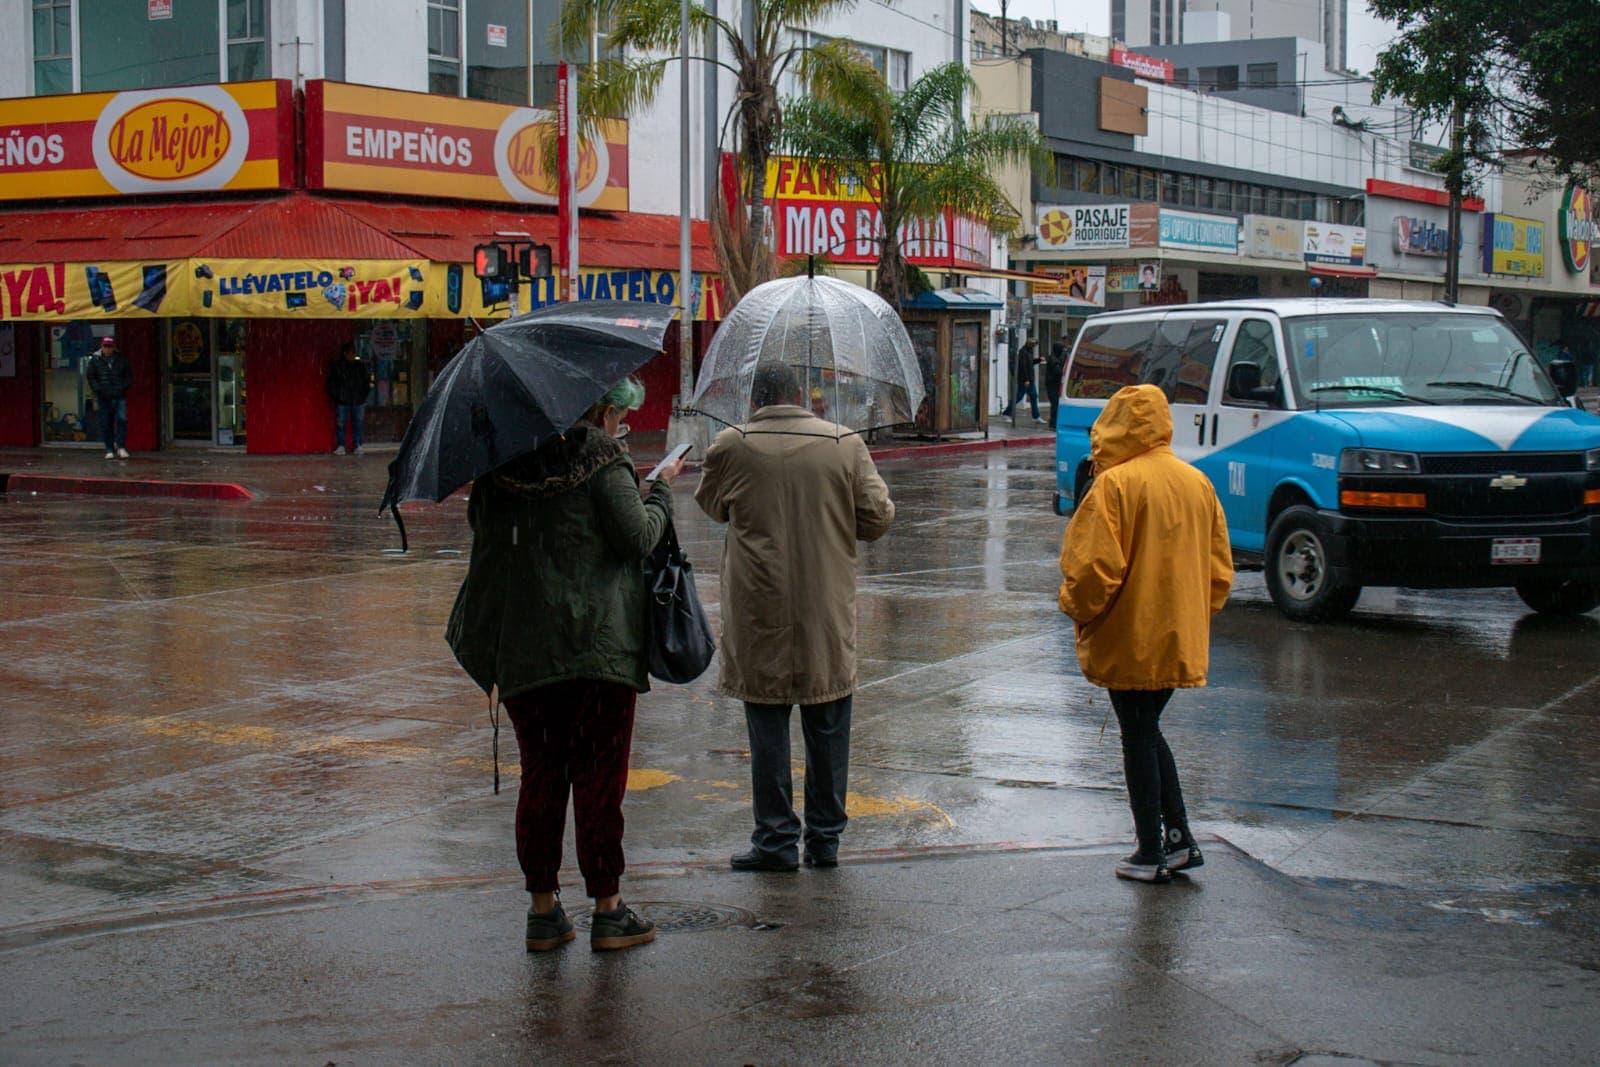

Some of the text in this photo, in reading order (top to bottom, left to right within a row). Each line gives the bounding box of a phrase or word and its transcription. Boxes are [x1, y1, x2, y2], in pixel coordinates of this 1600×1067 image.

[1121, 52, 1165, 79] Scotiabank
[116, 110, 224, 173] La Mejor!
[346, 126, 472, 168] EMPEÑOS
[785, 205, 845, 256] MAS
[1075, 208, 1128, 228] PASAJE
[1075, 228, 1127, 241] RODRIGUEZ
[0, 262, 66, 319] YA!
[219, 270, 334, 296] LLÉVATELO
[348, 277, 402, 312] ¡YA!
[530, 269, 675, 312] LLVATELO
[1304, 342, 1316, 357] 2
[1344, 376, 1402, 387] ALTAMIRA
[1228, 461, 1246, 496] TAXI
